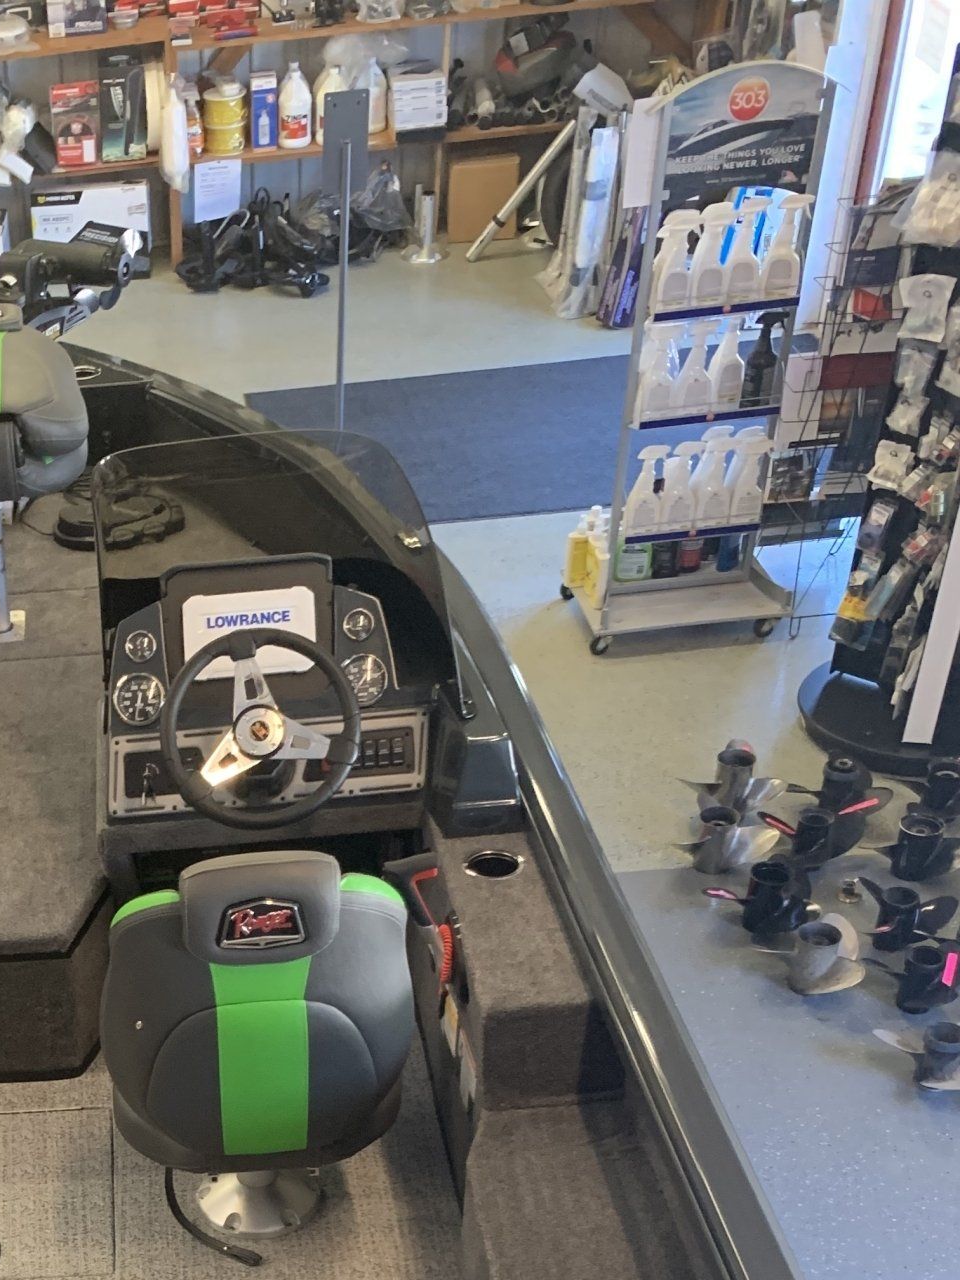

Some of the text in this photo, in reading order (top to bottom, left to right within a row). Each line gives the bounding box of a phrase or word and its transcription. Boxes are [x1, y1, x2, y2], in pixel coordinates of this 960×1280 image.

[731, 89, 766, 109] 303
[723, 149, 757, 160] THINGS
[781, 143, 806, 153] LOVE
[206, 610, 291, 630] LOWRANCE
